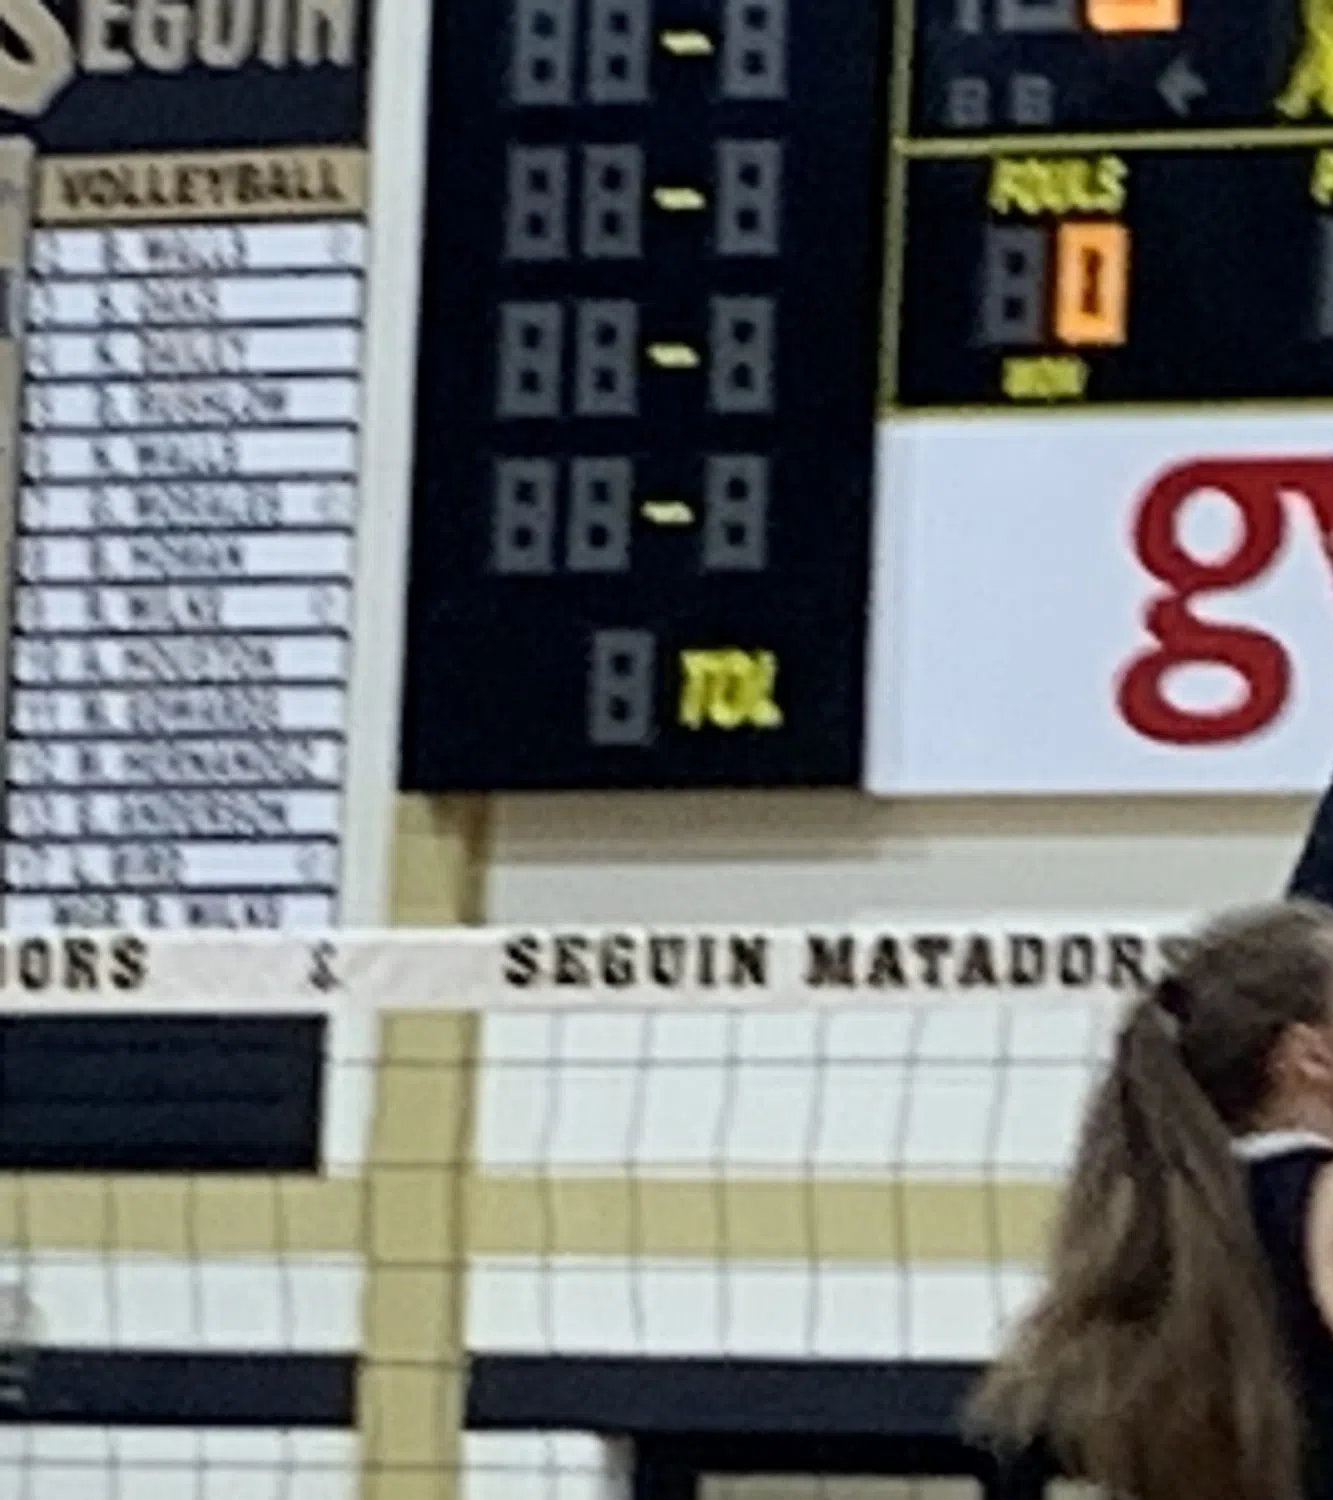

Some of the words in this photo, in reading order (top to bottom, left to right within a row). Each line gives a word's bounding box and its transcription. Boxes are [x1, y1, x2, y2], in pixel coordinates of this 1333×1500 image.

[61, 158, 346, 208] VOLLEYBALL
[987, 155, 1130, 213] FOULS
[1056, 221, 1131, 346] 0
[679, 647, 782, 730] TOL
[0, 936, 147, 991] ORS
[502, 932, 769, 986] SEGUIN
